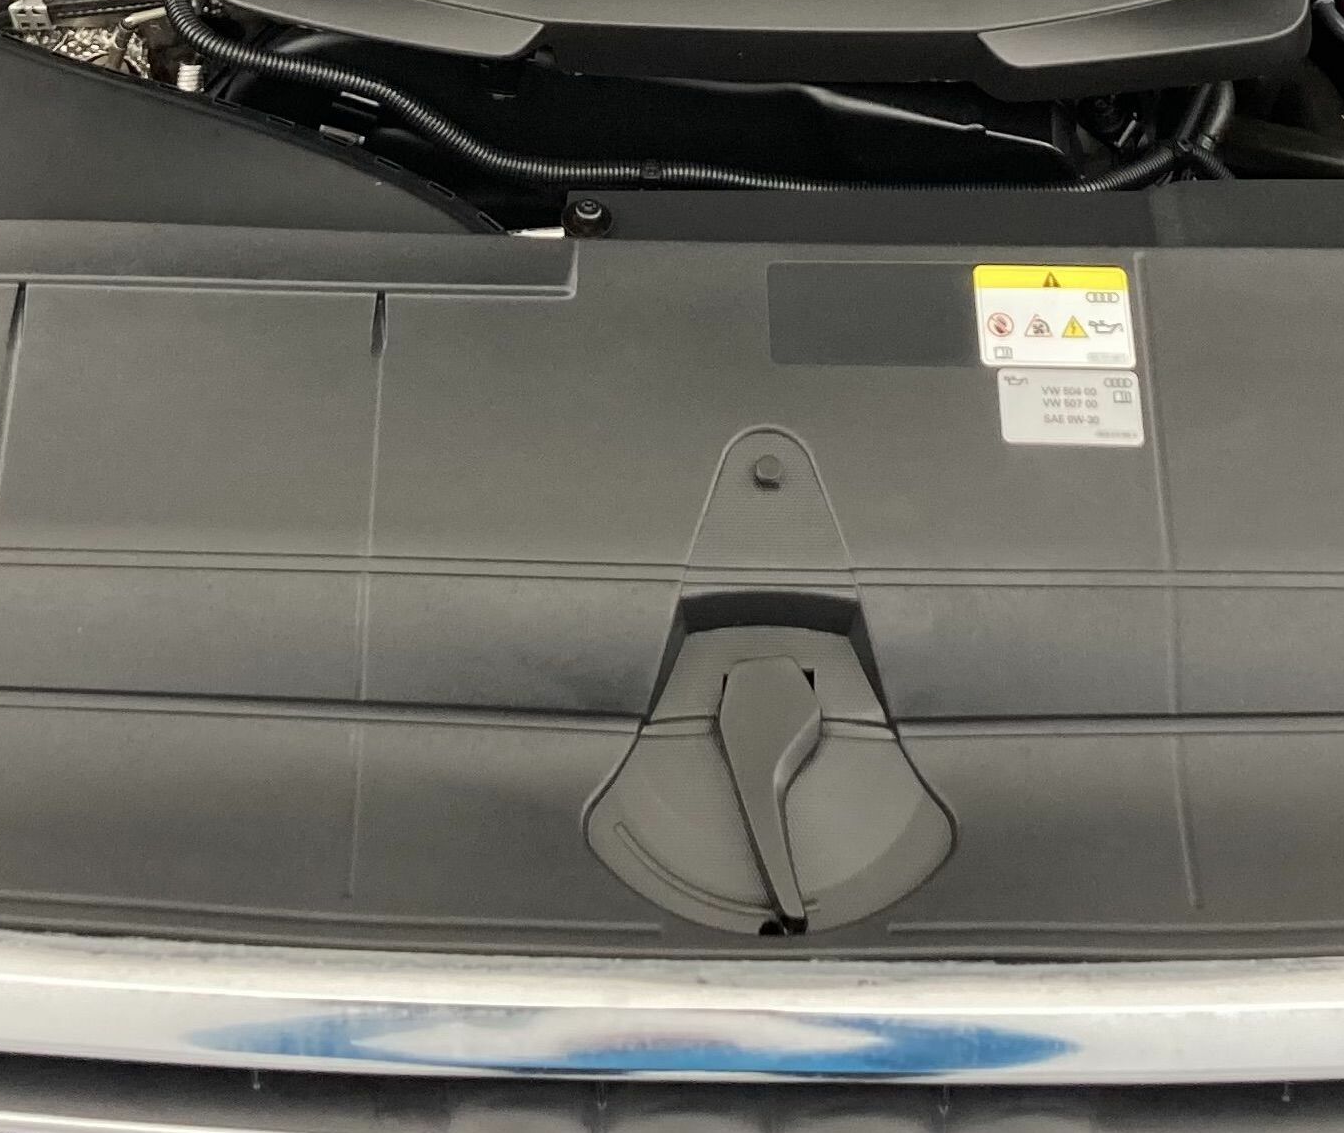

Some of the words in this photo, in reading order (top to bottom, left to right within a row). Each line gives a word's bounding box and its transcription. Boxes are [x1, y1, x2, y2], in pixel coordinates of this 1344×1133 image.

[1041, 385, 1061, 395] VW
[1083, 387, 1098, 397] 00
[1042, 397, 1062, 407] VW
[1084, 399, 1098, 409] 00
[1043, 413, 1065, 424] SAE
